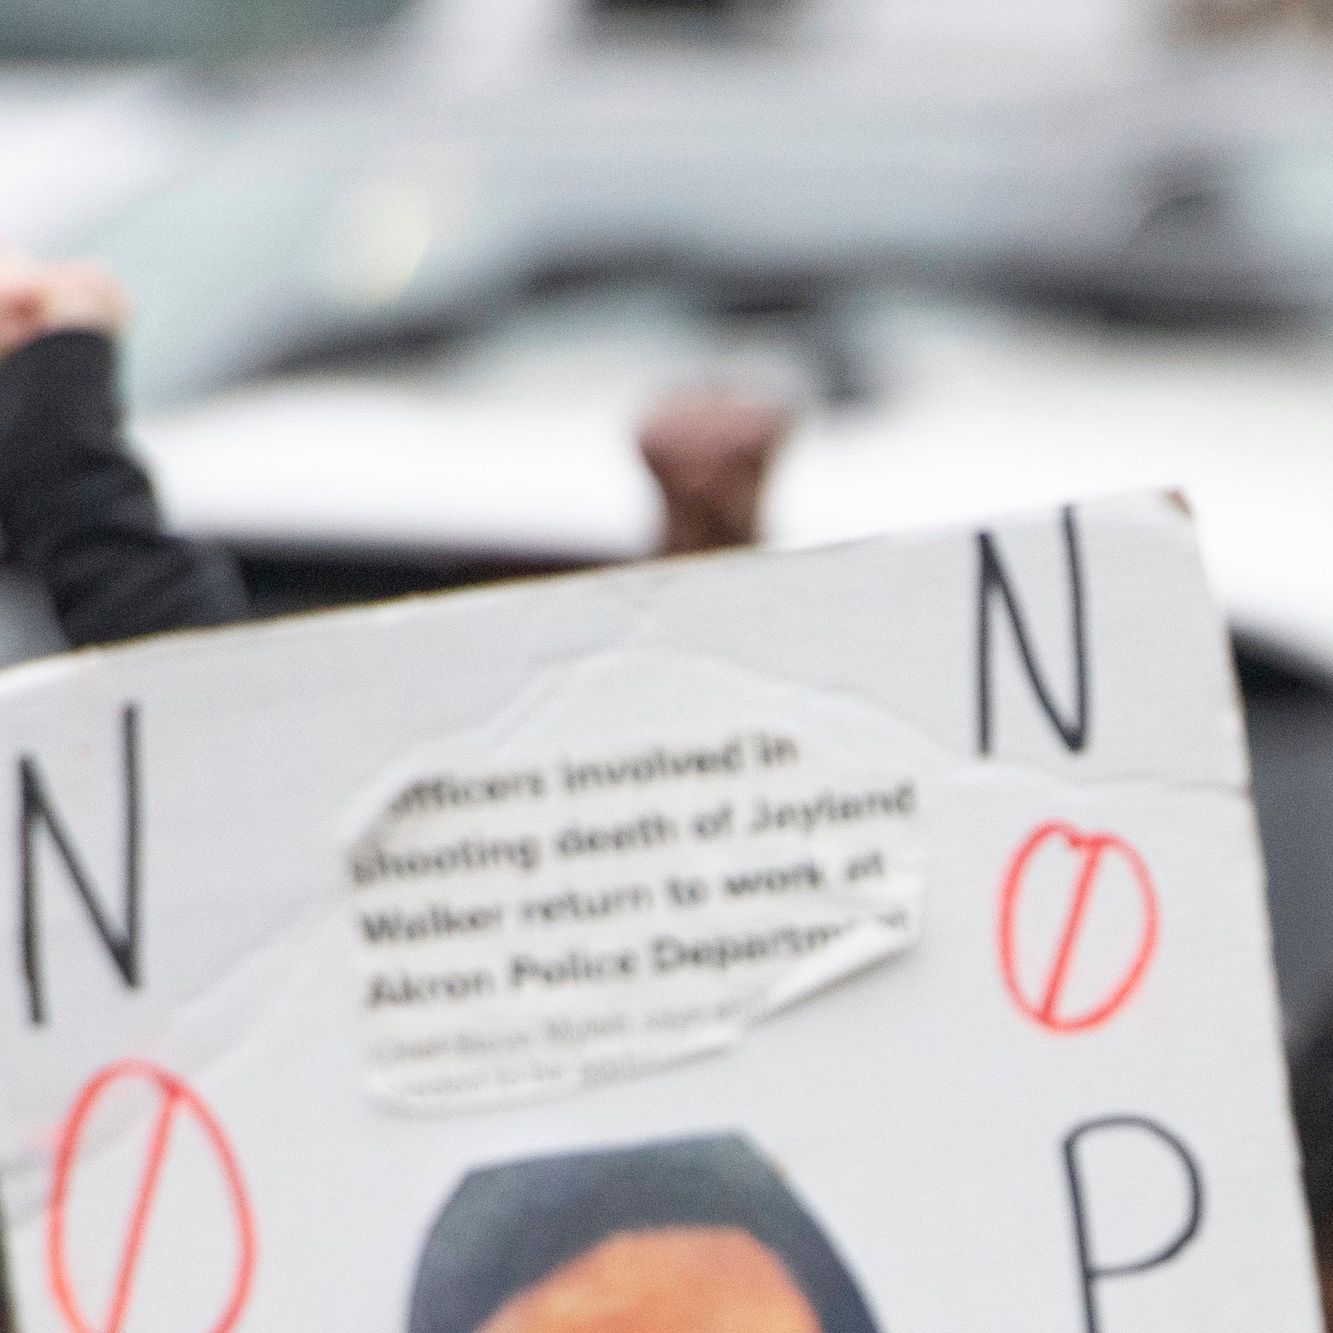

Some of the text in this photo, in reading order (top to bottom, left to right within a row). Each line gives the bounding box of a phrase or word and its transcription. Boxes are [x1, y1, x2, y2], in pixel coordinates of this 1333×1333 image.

[561, 735, 742, 792] involved
[755, 730, 799, 766] in
[556, 811, 679, 860] death
[694, 802, 735, 841] of
[747, 778, 919, 838] Jayland
[358, 847, 887, 947] Walker return to work at
[364, 966, 494, 1010] Akron
[507, 942, 636, 990] Police
